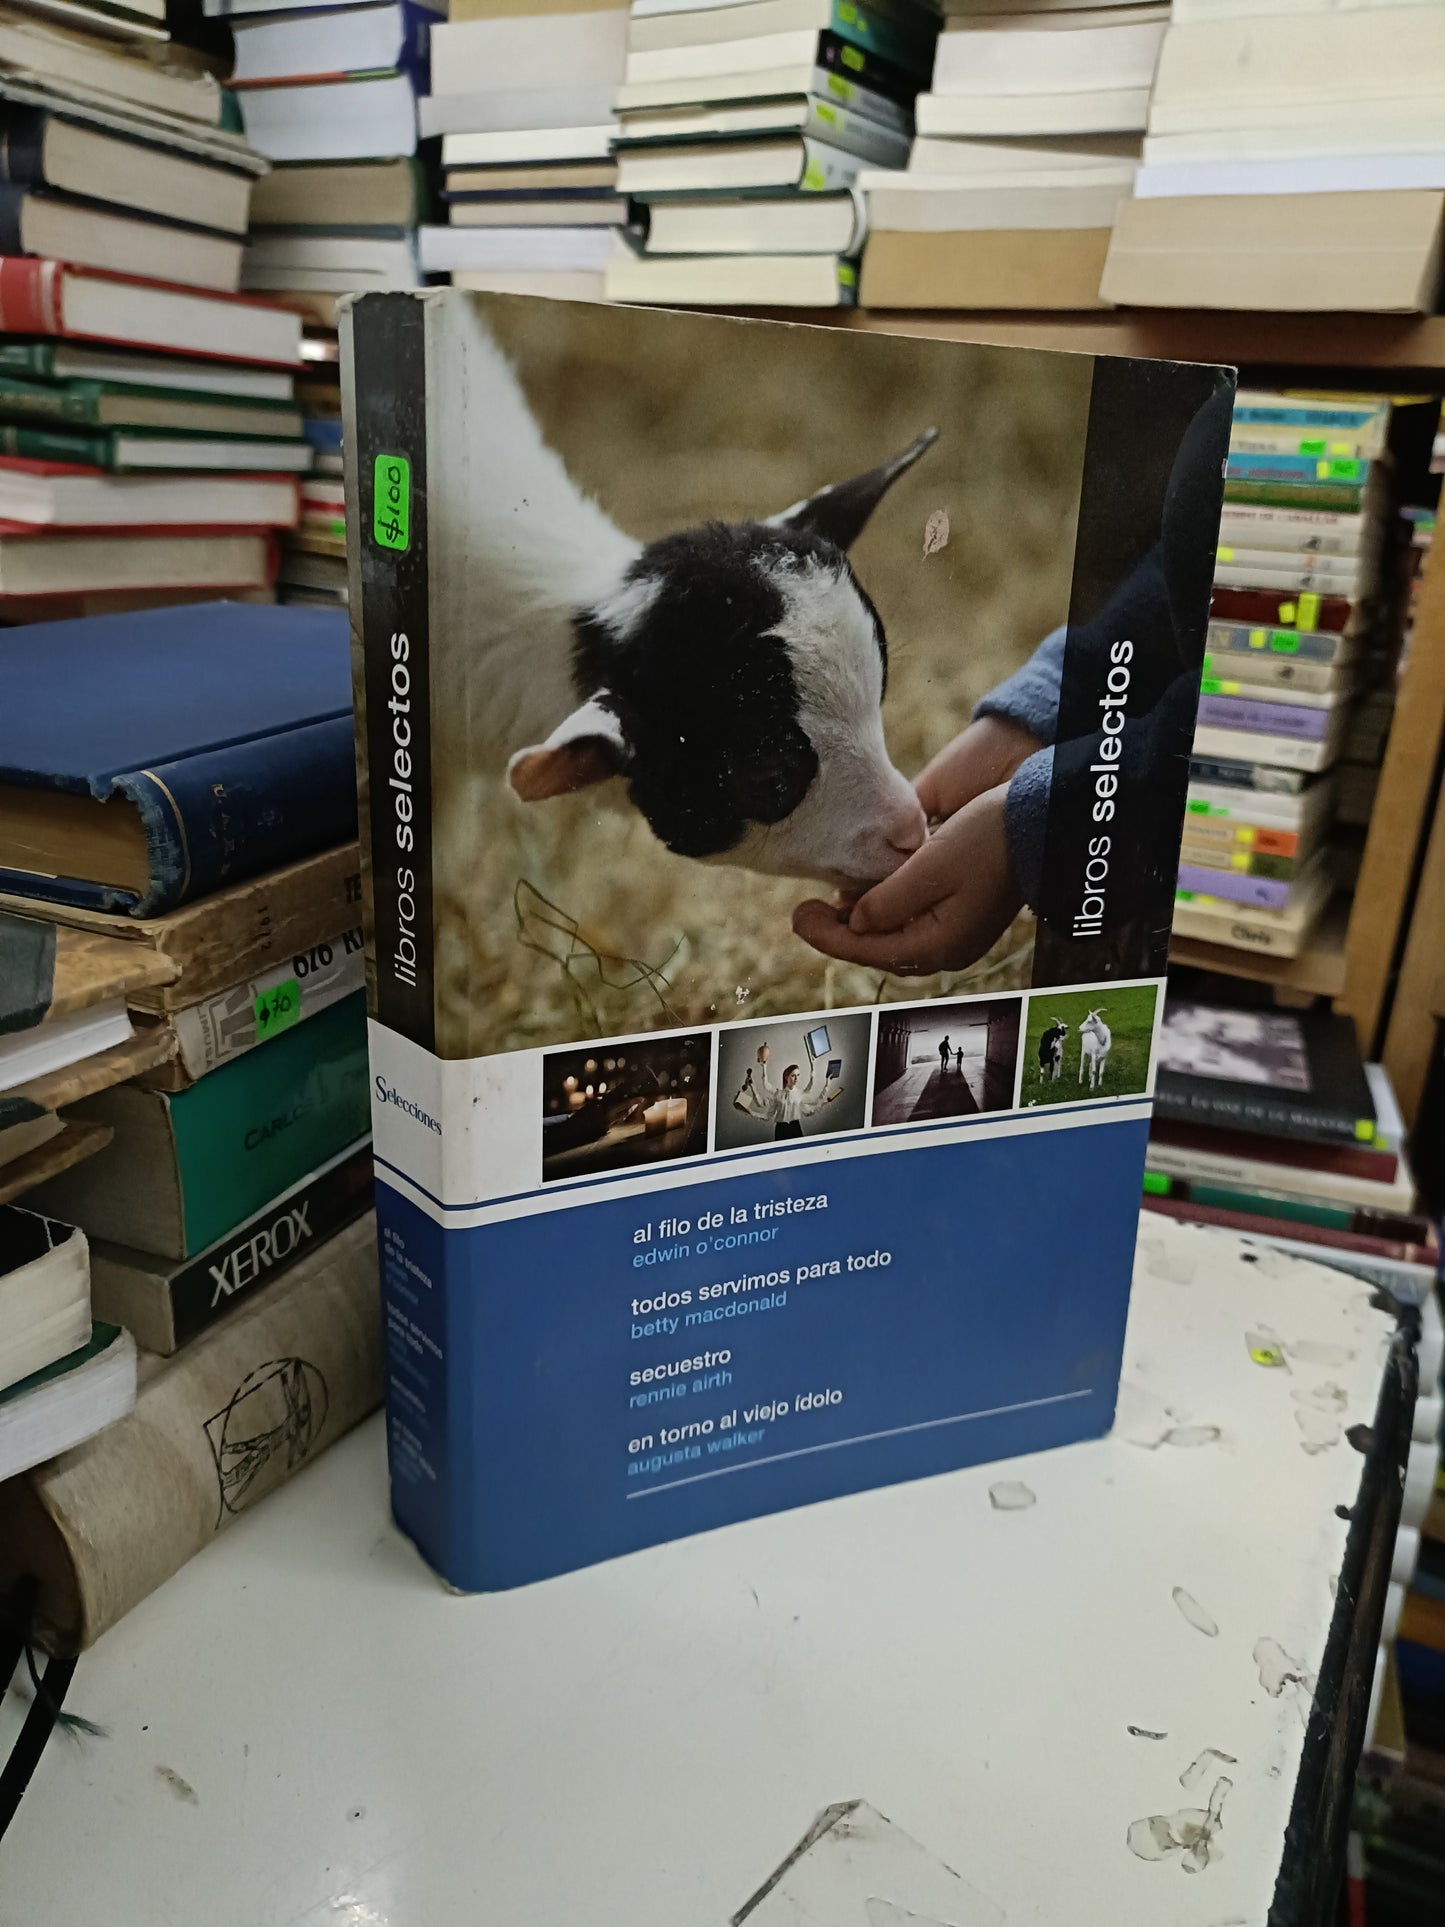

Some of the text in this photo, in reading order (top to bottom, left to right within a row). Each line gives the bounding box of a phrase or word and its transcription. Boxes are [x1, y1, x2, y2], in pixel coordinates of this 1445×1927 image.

[378, 466, 404, 543] $100
[387, 632, 417, 987] libros selectos
[1072, 640, 1134, 937] libros selectos
[375, 1075, 442, 1136] Selecciones
[632, 1227, 779, 1268] edwin o'connor
[633, 1194, 828, 1244] al filo de la tristeza
[208, 1200, 313, 1308] XEROX
[631, 1249, 892, 1316] todos servimos para todo
[631, 1291, 787, 1340] betty macdonald
[629, 1349, 732, 1386] secuestro
[629, 1370, 732, 1409] rennie airth
[628, 1388, 843, 1454] en torno al viejo ídolo
[628, 1428, 766, 1476] augusta walker
